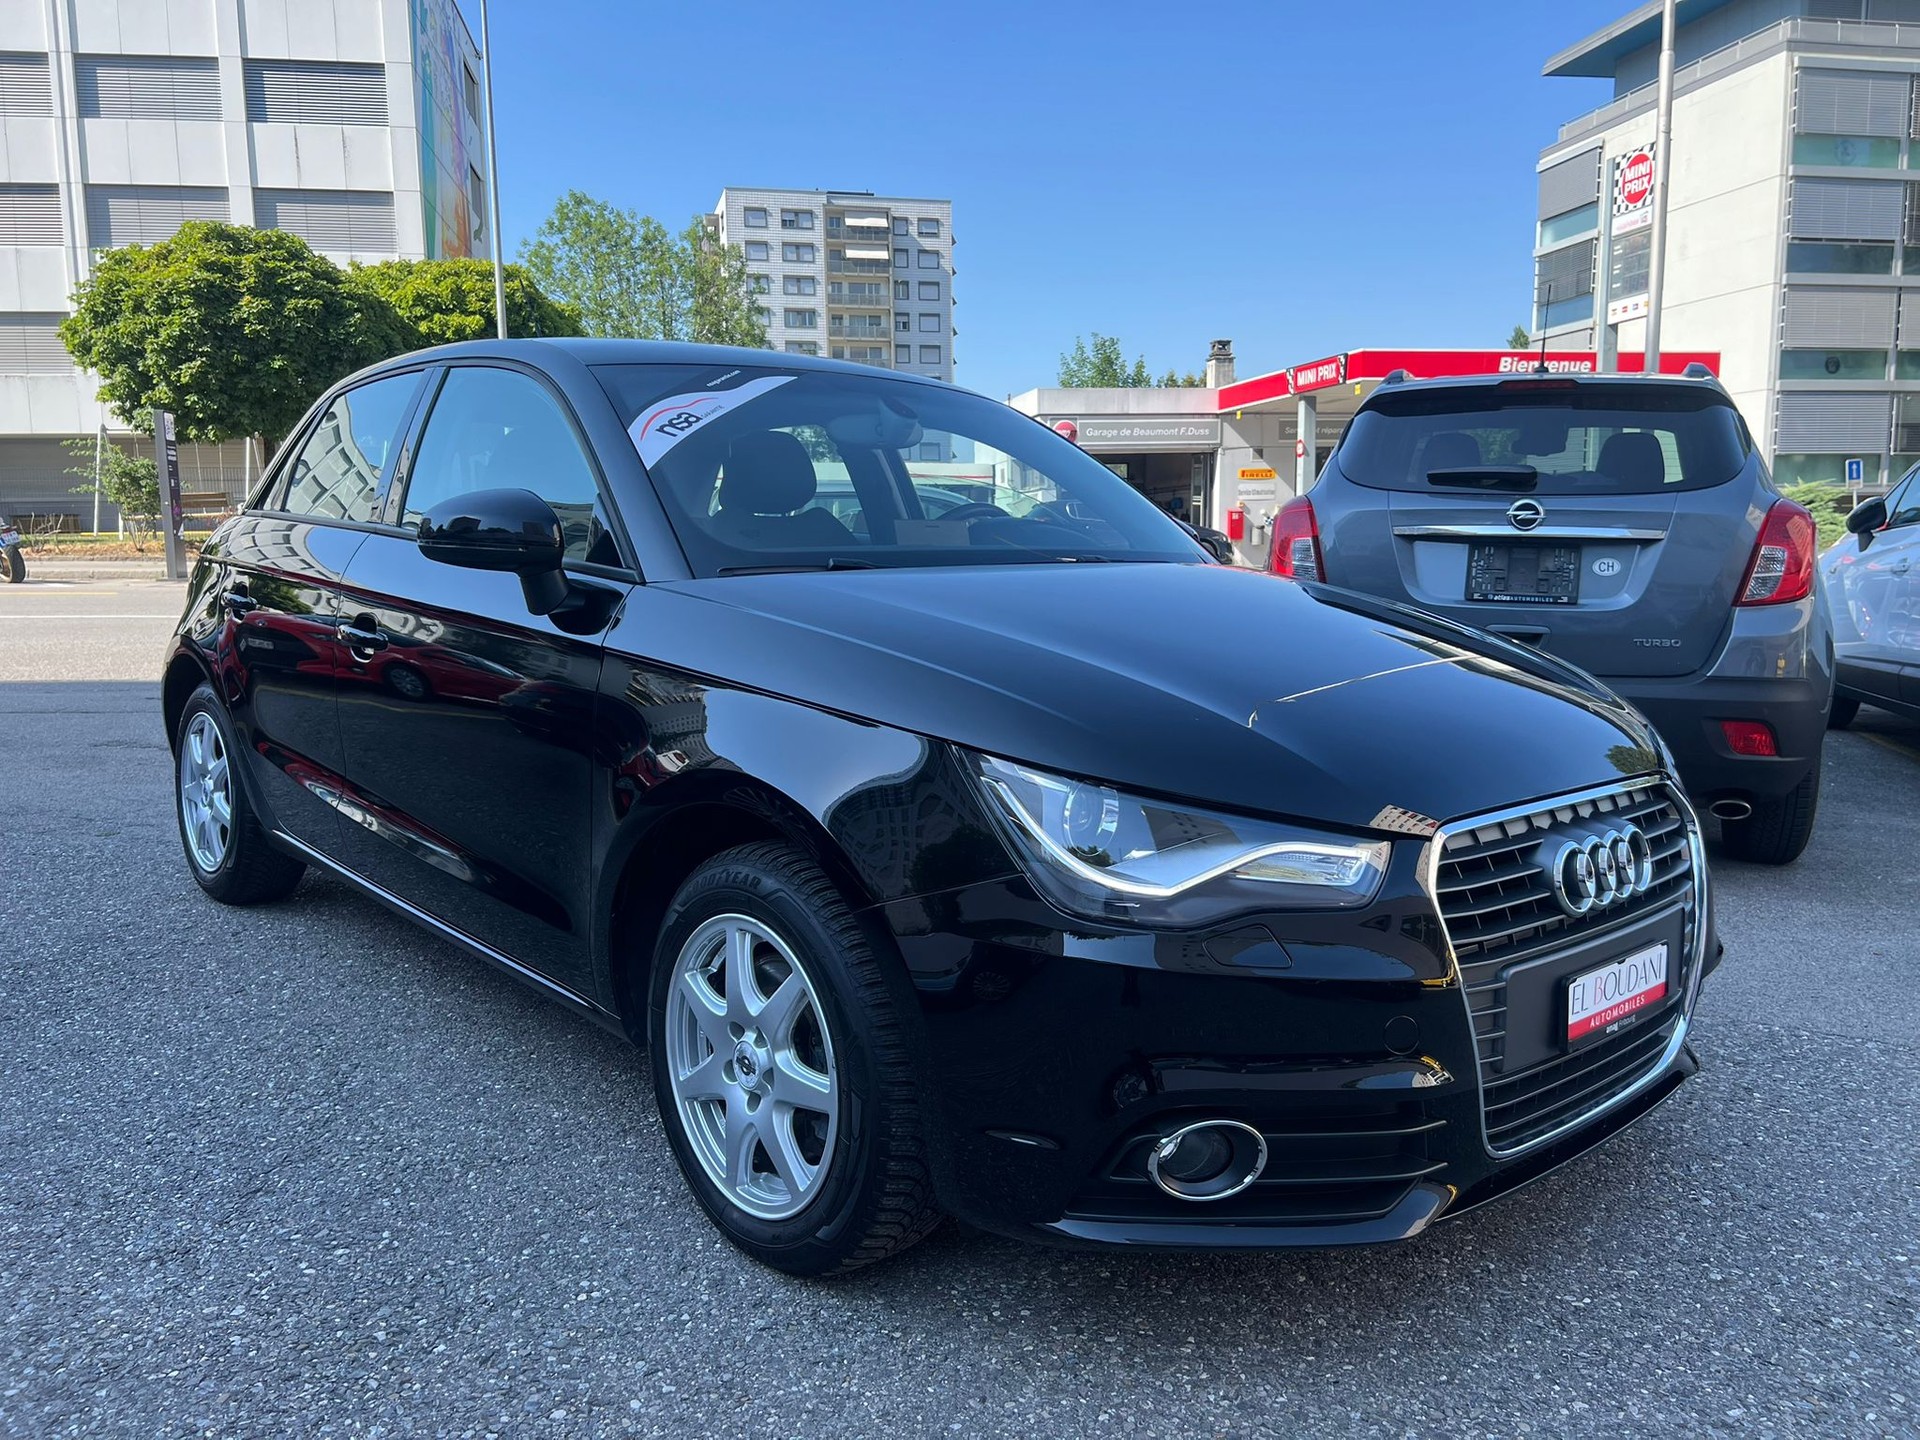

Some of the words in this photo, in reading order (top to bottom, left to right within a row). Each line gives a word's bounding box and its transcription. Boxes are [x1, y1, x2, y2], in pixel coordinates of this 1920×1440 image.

[1624, 160, 1651, 182] MINI
[1623, 174, 1650, 197] PRIX
[1296, 368, 1317, 387] MINI
[1317, 362, 1338, 383] PRIX
[1498, 356, 1592, 373] Bienenue
[655, 411, 703, 437] nsa
[1086, 427, 1118, 438] Garage
[1119, 427, 1132, 437] de
[1134, 426, 1178, 437] Beaumont
[1180, 426, 1210, 437] F.Duss
[1598, 561, 1616, 573] CH
[1633, 638, 1681, 647] TURBO
[1572, 982, 1589, 1016] EL
[1594, 951, 1663, 1006] BOUDANI
[1589, 994, 1646, 1029] AUTOMOBILES
